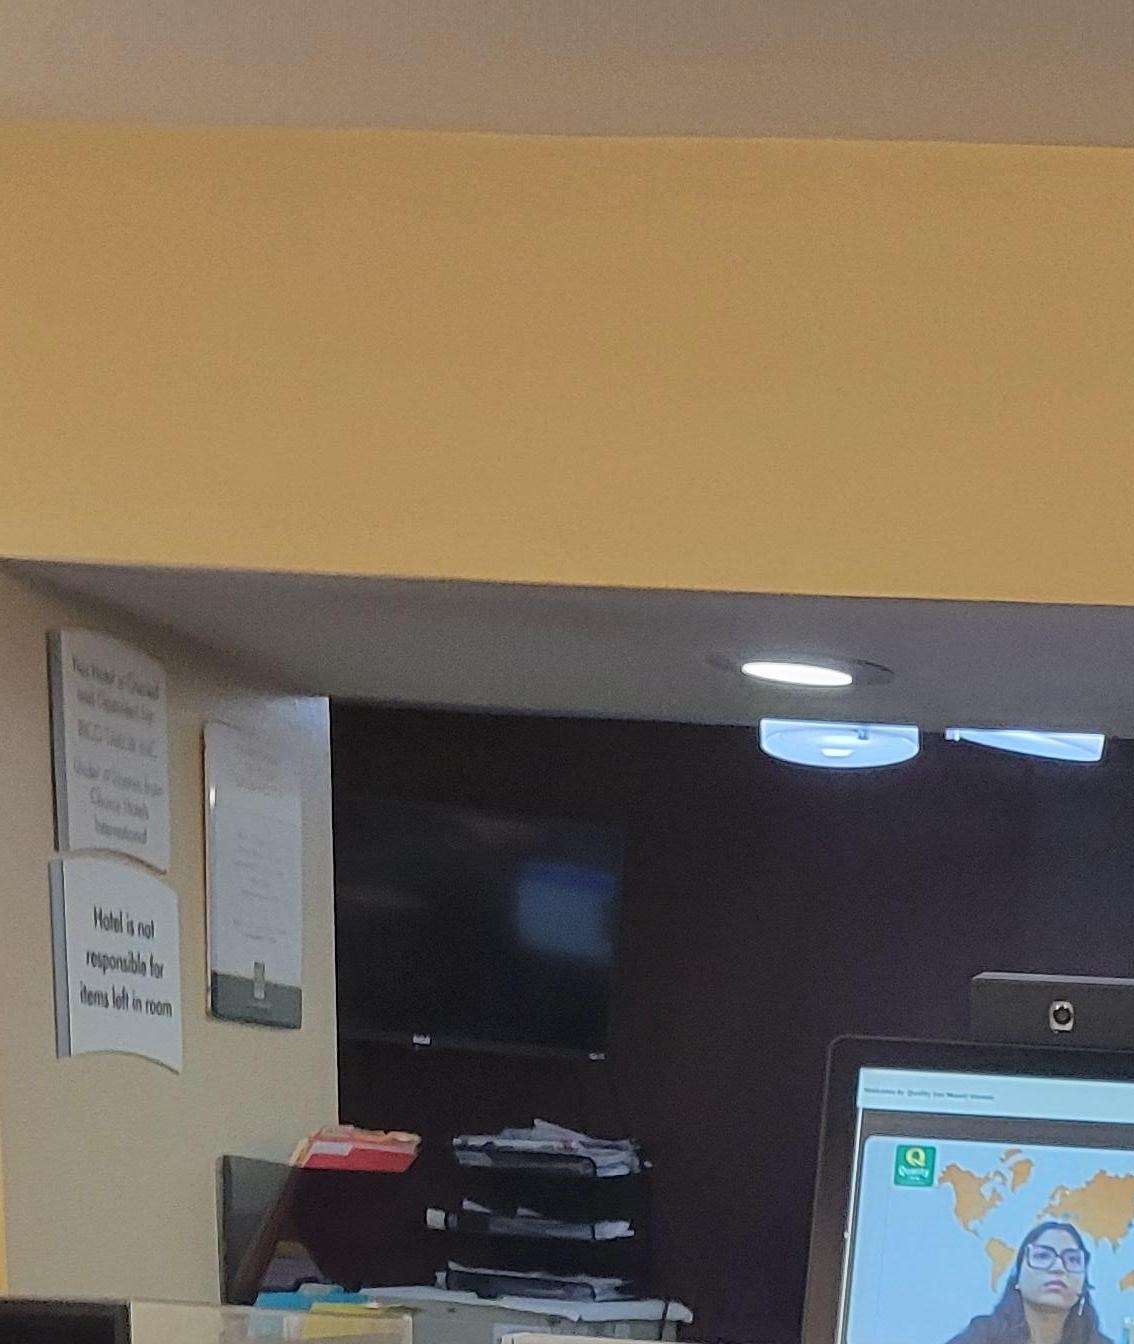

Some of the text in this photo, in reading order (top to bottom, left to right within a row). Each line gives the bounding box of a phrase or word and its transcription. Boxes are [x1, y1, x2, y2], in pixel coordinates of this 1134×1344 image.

[93, 904, 155, 940] Hotel is not
[86, 949, 164, 979] responsible for
[80, 980, 173, 1018] items left in room
